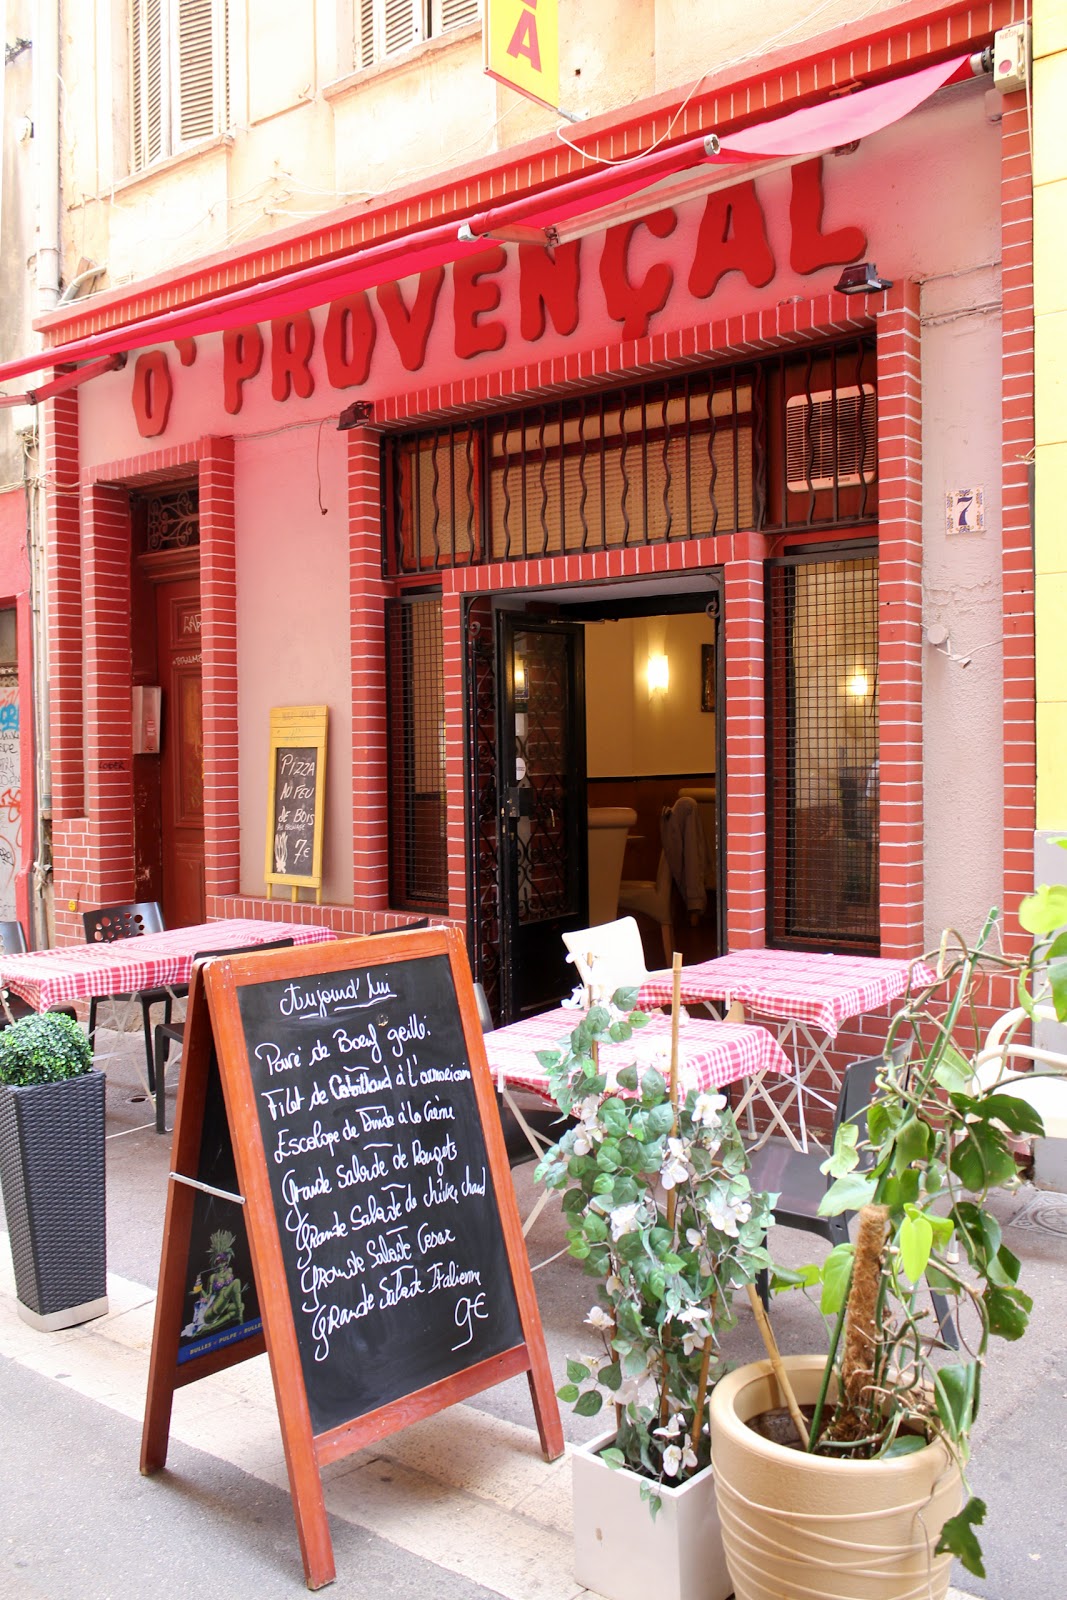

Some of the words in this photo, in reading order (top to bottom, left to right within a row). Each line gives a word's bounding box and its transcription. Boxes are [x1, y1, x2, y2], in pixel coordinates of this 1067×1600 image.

[222, 157, 868, 416] PROVENÇAL
[956, 496, 973, 526] 7
[280, 753, 315, 777] PIZZA
[293, 784, 315, 800] FEU
[293, 838, 311, 865] 7€
[309, 1039, 331, 1066] de
[261, 1086, 306, 1121] Filet
[308, 1081, 329, 1111] de
[396, 1063, 406, 1086] à
[274, 1120, 341, 1164] Escalope
[342, 1118, 360, 1141] de
[408, 1100, 422, 1123] la
[336, 1152, 390, 1189] Salade
[392, 1143, 409, 1170] de
[350, 1190, 403, 1231] Salade
[404, 1183, 418, 1213] de
[460, 1165, 487, 1198] chaud
[365, 1233, 412, 1269] Salade
[189, 1341, 213, 1356] BULLES
[218, 1331, 238, 1345] PULPE
